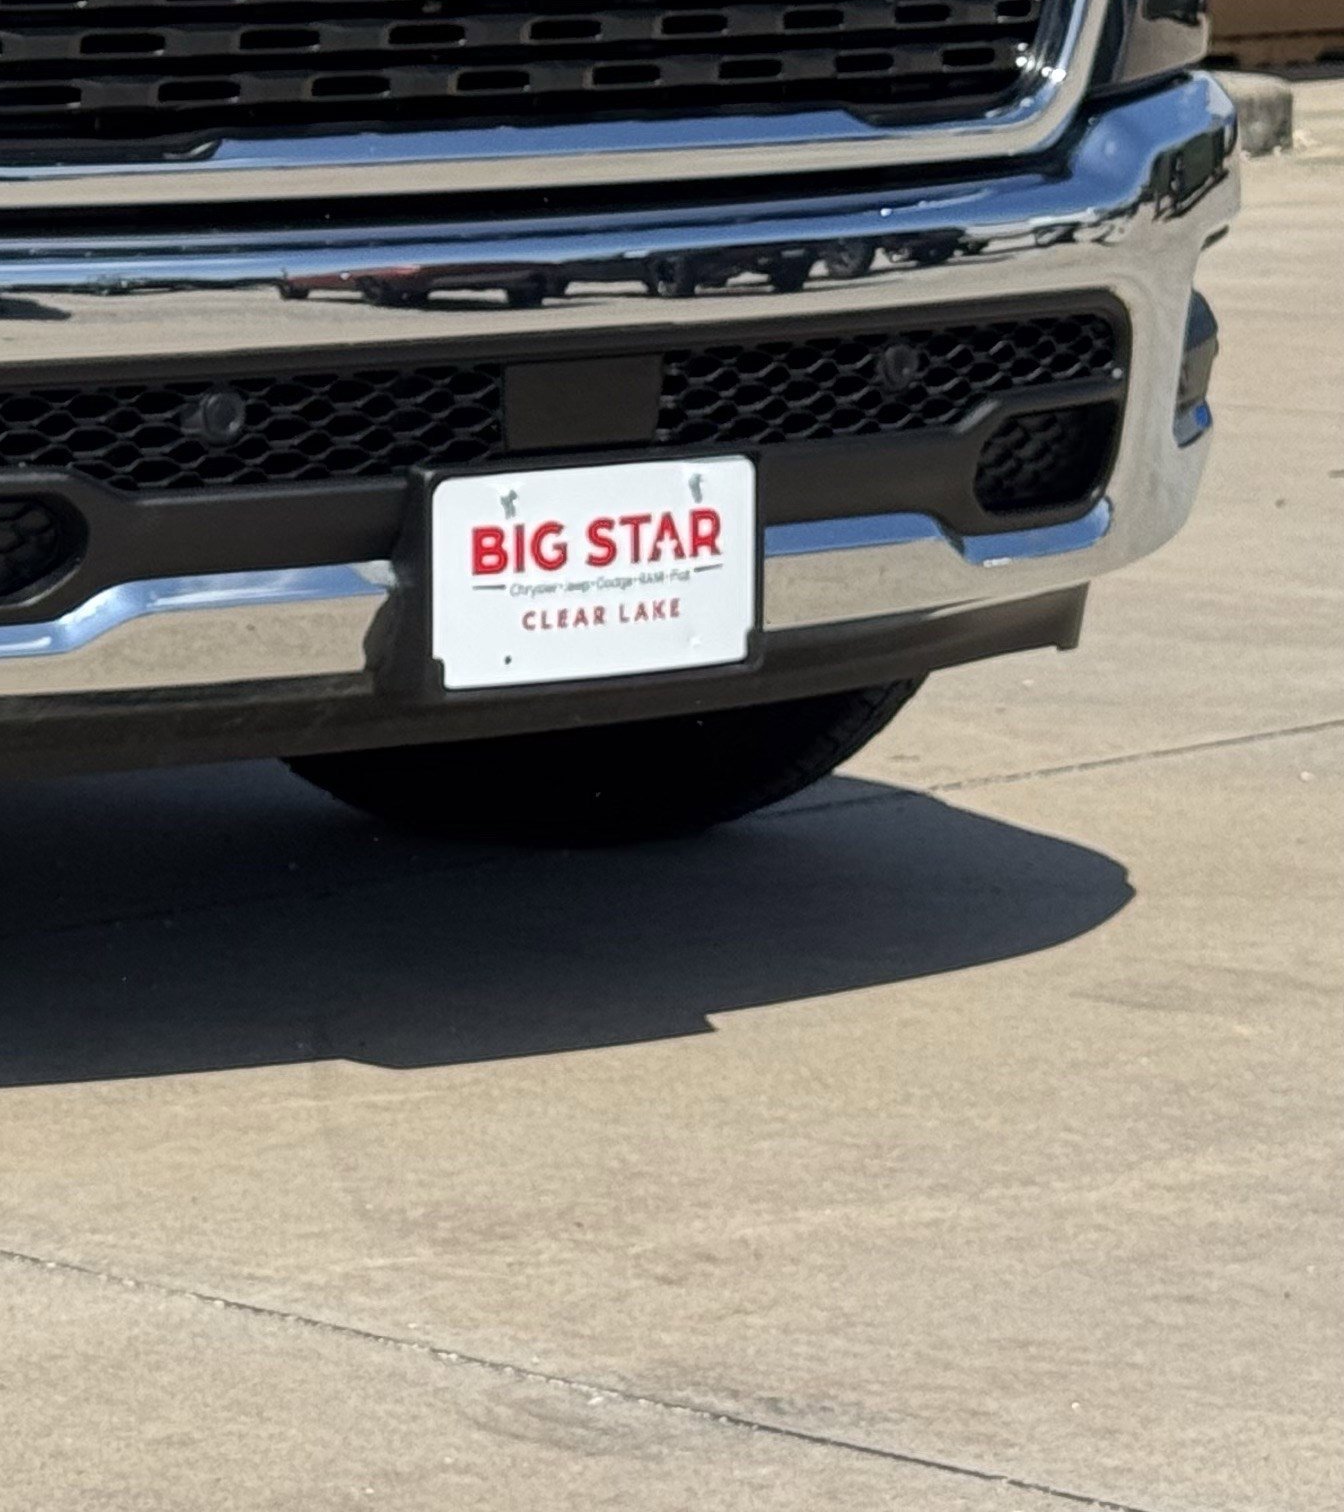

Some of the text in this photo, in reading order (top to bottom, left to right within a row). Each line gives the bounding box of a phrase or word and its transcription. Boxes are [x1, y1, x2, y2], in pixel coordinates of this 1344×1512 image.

[472, 507, 722, 576] BIG STAR
[521, 597, 682, 632] CLEAR LAKE
